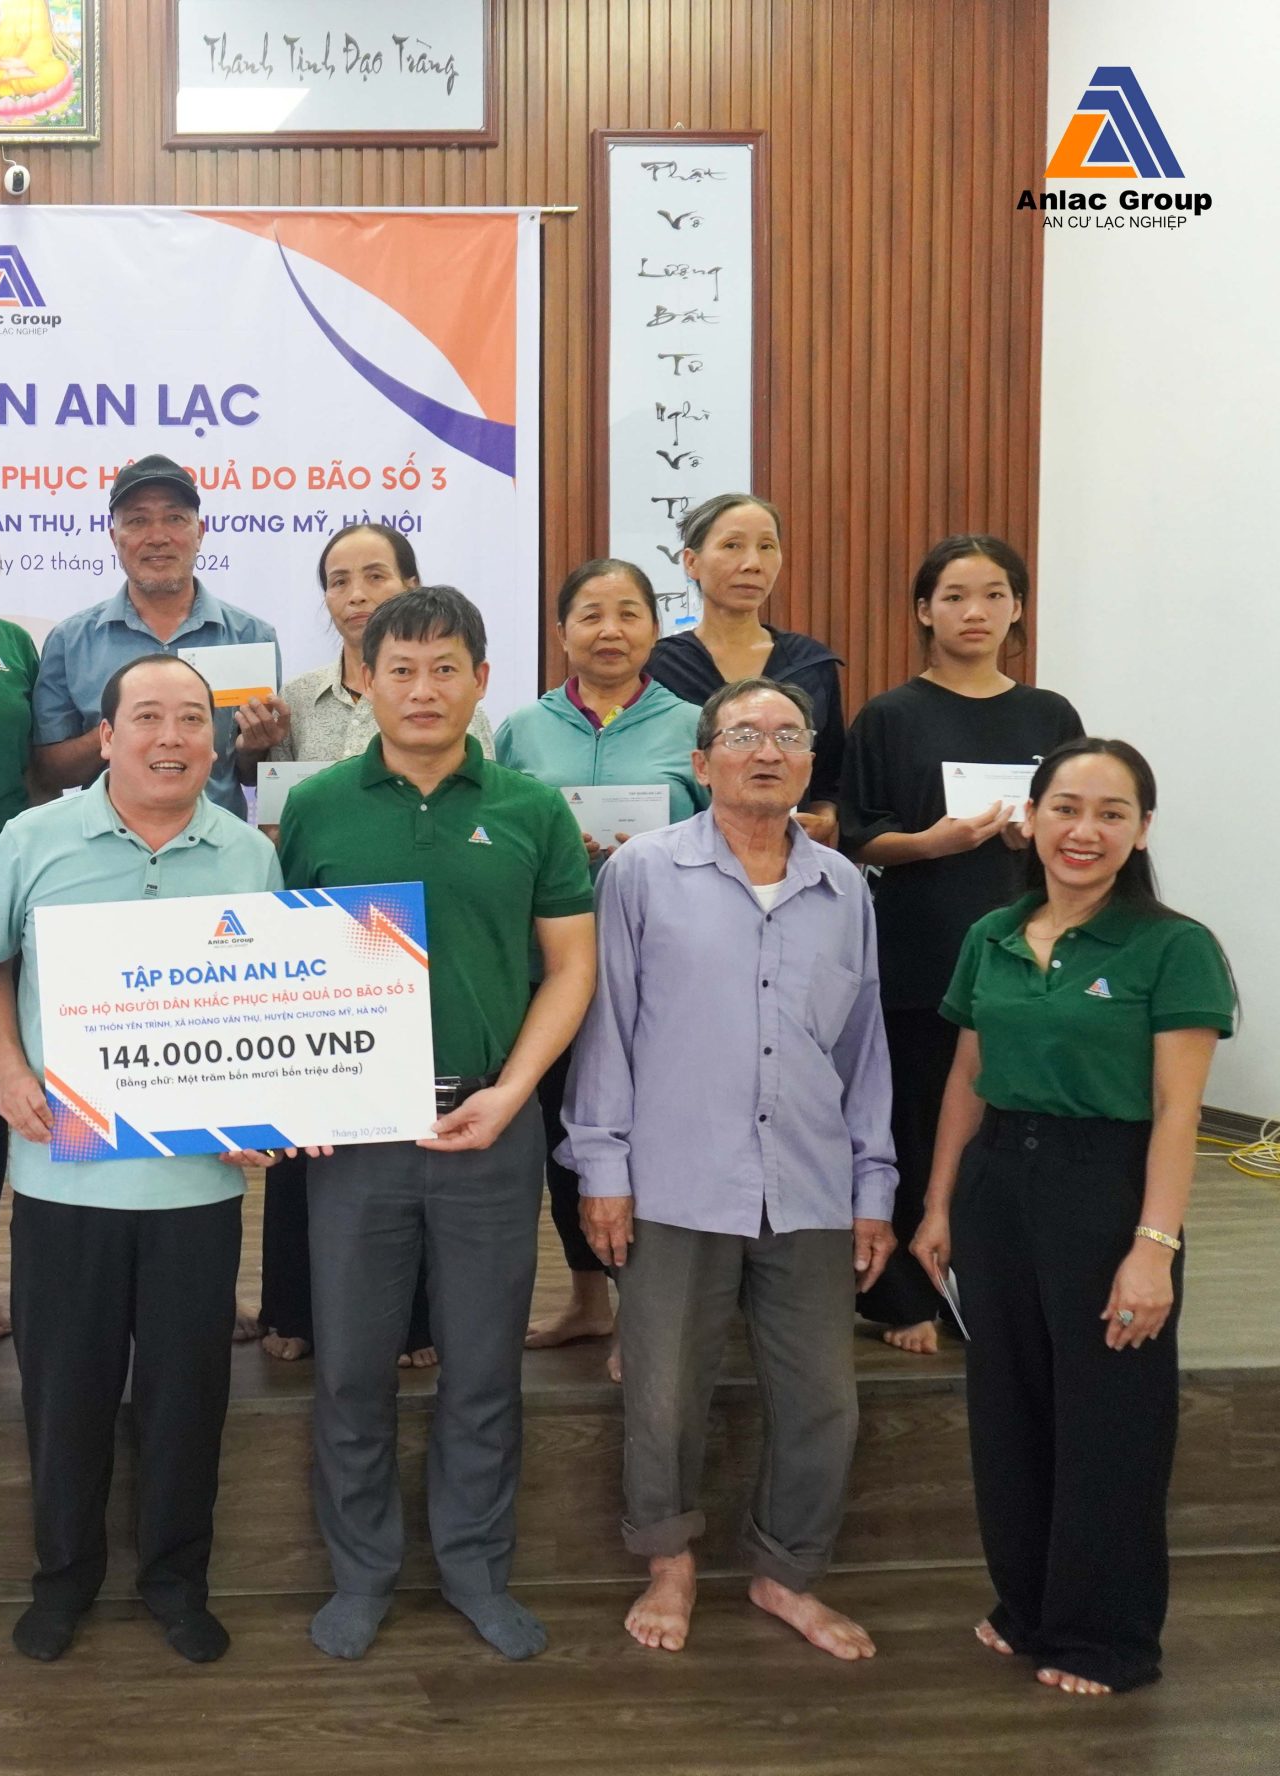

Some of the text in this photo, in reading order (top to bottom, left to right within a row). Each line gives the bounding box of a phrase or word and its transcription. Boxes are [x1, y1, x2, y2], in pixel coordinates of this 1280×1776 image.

[204, 31, 459, 96] Thanh Tịnh Đạo Tràng
[11, 313, 62, 328] Group
[54, 383, 136, 426] AN
[158, 383, 261, 438] LẠC
[2, 465, 88, 496] PHỤC
[252, 466, 297, 490] DO
[308, 460, 371, 490] BÃO
[381, 452, 421, 491] SỐ
[431, 467, 447, 491] 3
[29, 514, 82, 537] THỤ,
[205, 514, 285, 533] ƯƠNG
[293, 510, 334, 537] MỸ,
[381, 510, 422, 537] NỘI
[21, 555, 44, 570] 02
[51, 551, 103, 575] tháng
[195, 555, 230, 570] 024
[121, 959, 327, 992] TẬP ĐOÀN AN LẠC
[92, 1001, 111, 1016] HỘ
[115, 1000, 159, 1013] NGƯỜI
[163, 997, 190, 1010] DÂN
[194, 992, 230, 1008] KHẮC
[233, 993, 268, 1006] PHỤC
[272, 989, 298, 1005] HẬU
[302, 987, 330, 1001] QUẢ
[334, 988, 352, 999] DO
[356, 985, 383, 998] BÃO
[387, 979, 404, 994] SỐ
[407, 984, 415, 994] 3
[99, 1030, 375, 1070] 144.000.000 VNĐ
[115, 1077, 148, 1090] (Bằng
[178, 1073, 199, 1084] Một
[201, 1071, 226, 1082] trăm
[229, 1068, 249, 1080] bốn
[282, 1064, 302, 1077] bốn
[304, 1064, 329, 1076] triệu
[332, 1061, 364, 1076] đồng)
[331, 1126, 398, 1138] Tháng 10/2024
